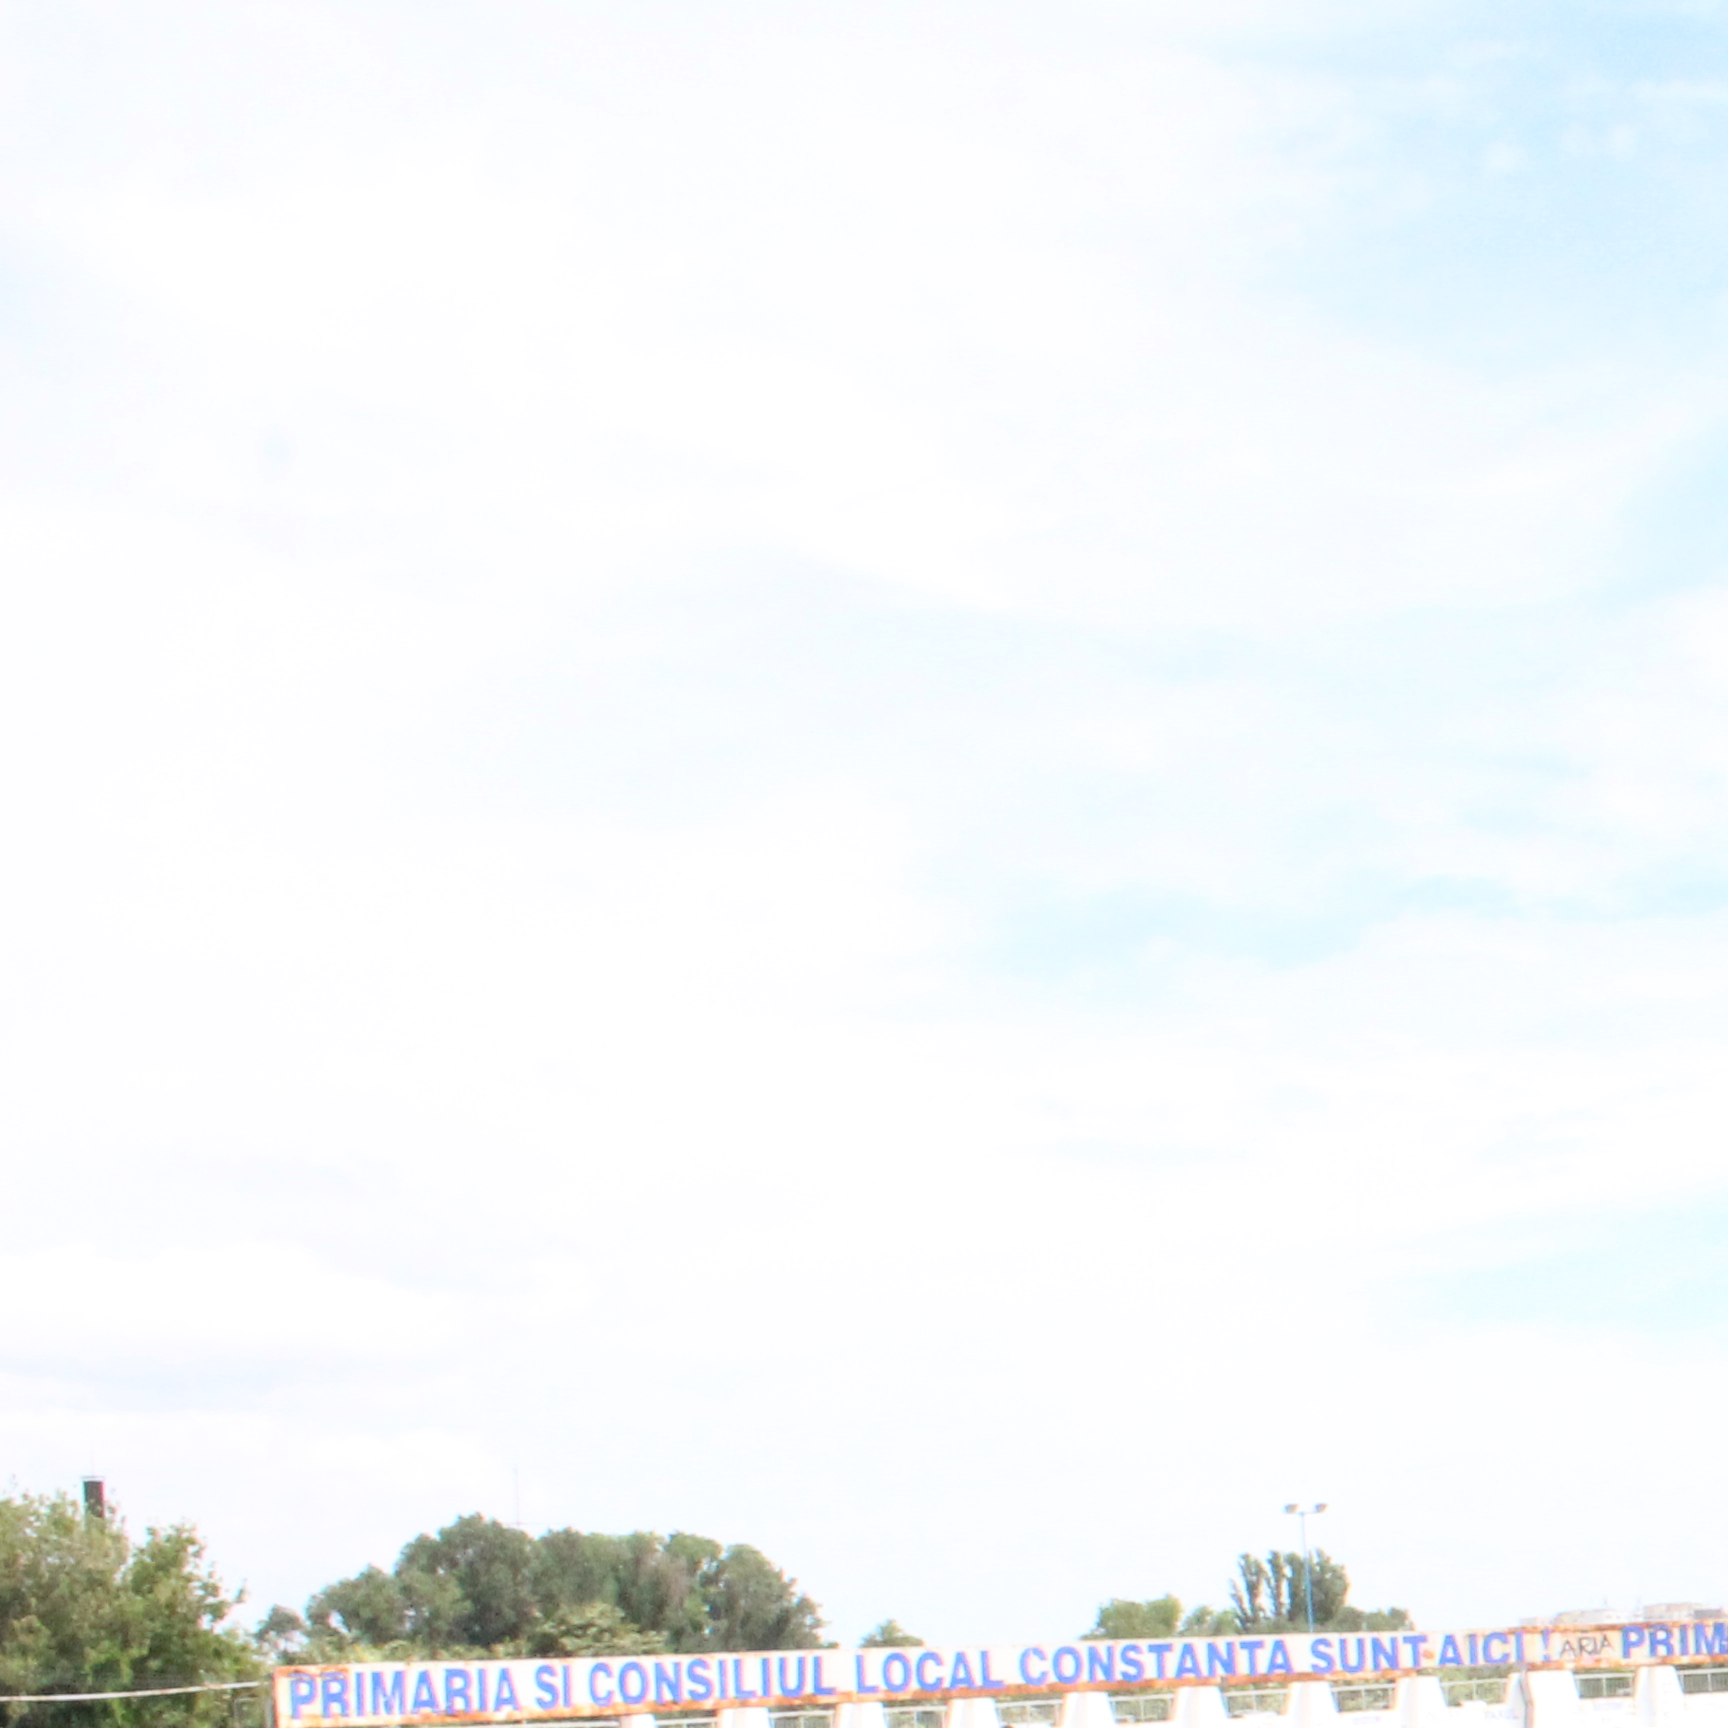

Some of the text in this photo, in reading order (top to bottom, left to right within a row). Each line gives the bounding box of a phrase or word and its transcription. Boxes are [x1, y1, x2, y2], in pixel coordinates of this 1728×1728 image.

[290, 1667, 520, 1720] PRIMARIA
[535, 1665, 571, 1710] SI
[588, 1656, 836, 1708] CONSILIUL
[856, 1650, 1006, 1695] LOCAL
[1019, 1640, 1294, 1687] CONSTANTA
[1310, 1635, 1428, 1675] SUNT
